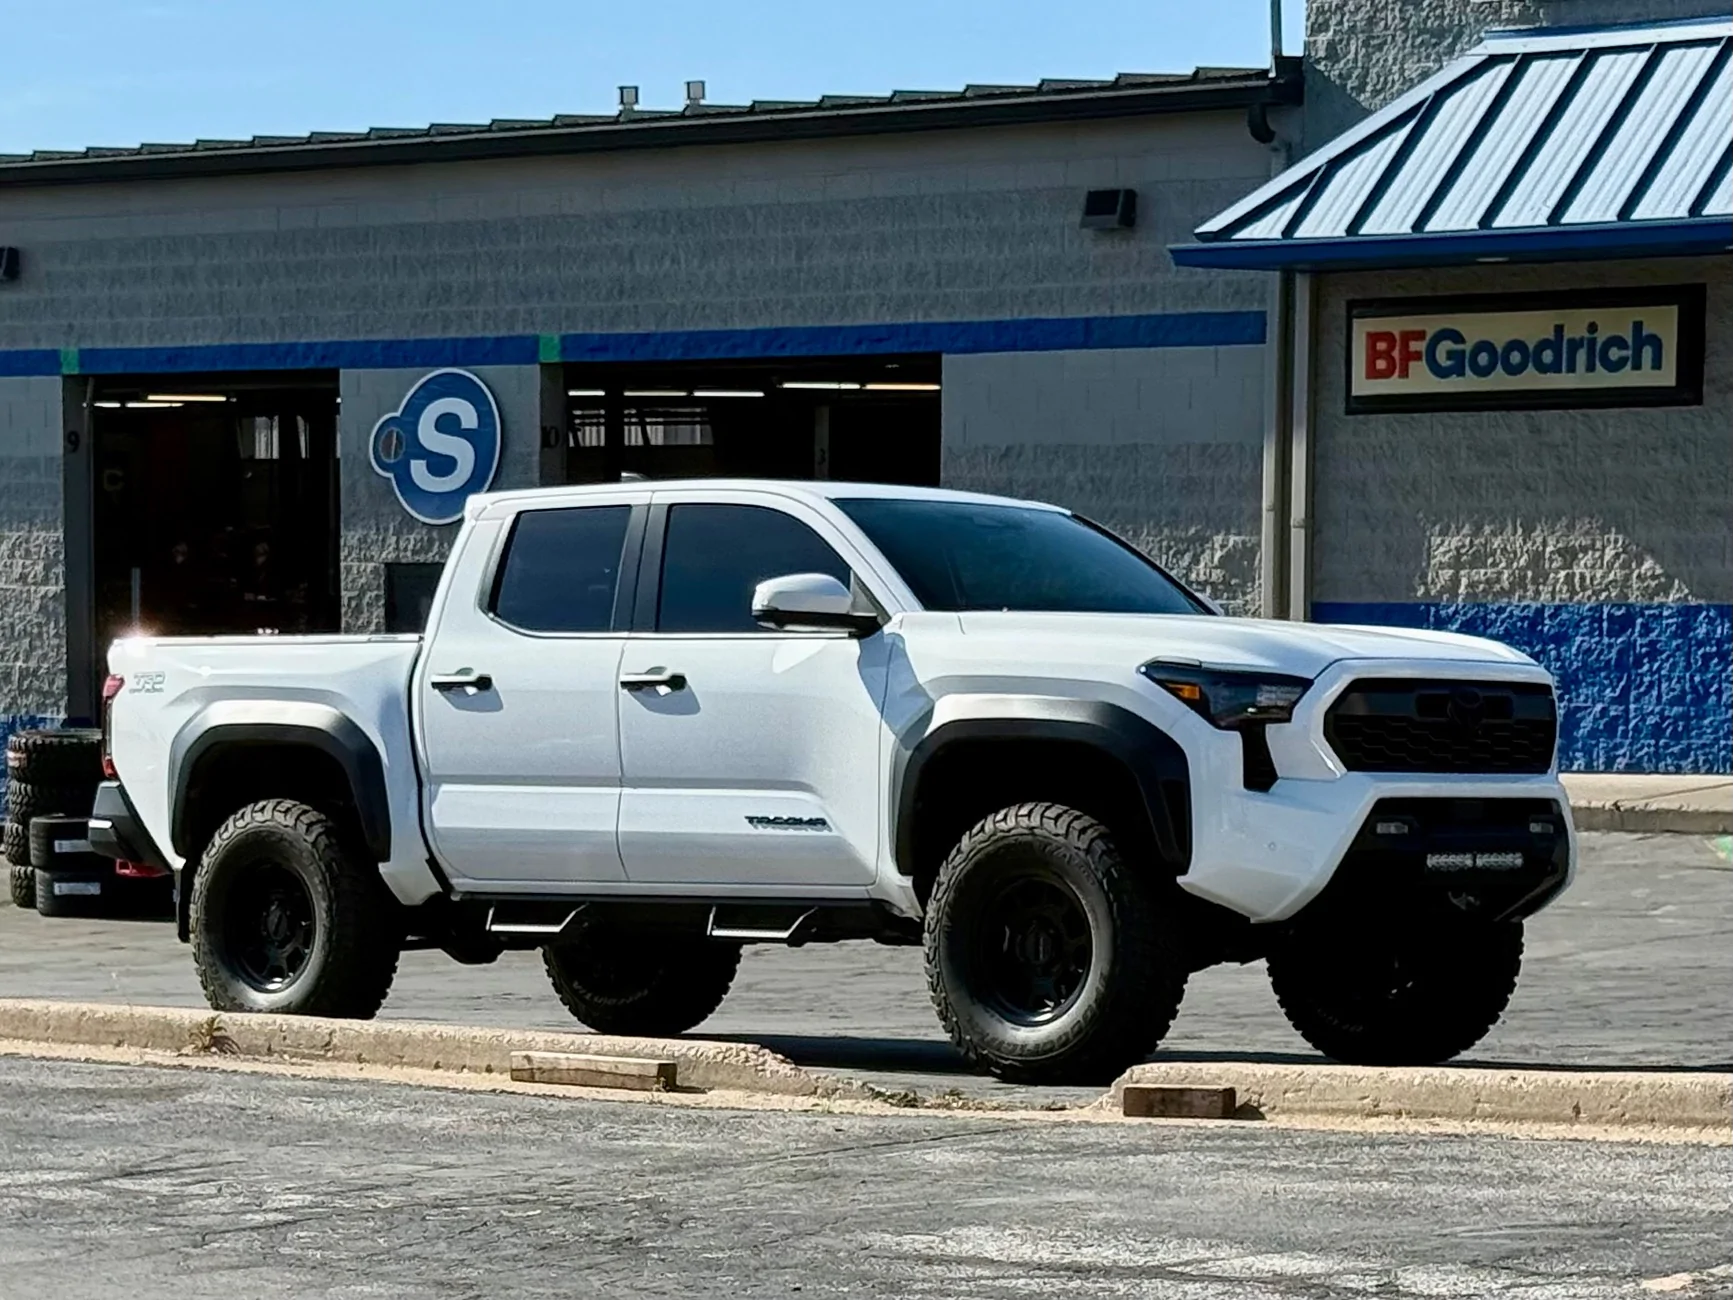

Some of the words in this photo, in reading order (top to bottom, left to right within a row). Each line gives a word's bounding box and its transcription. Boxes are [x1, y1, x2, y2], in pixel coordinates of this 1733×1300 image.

[1365, 320, 1663, 380] BFGoodrich
[67, 431, 80, 453] 9
[410, 397, 479, 493] S
